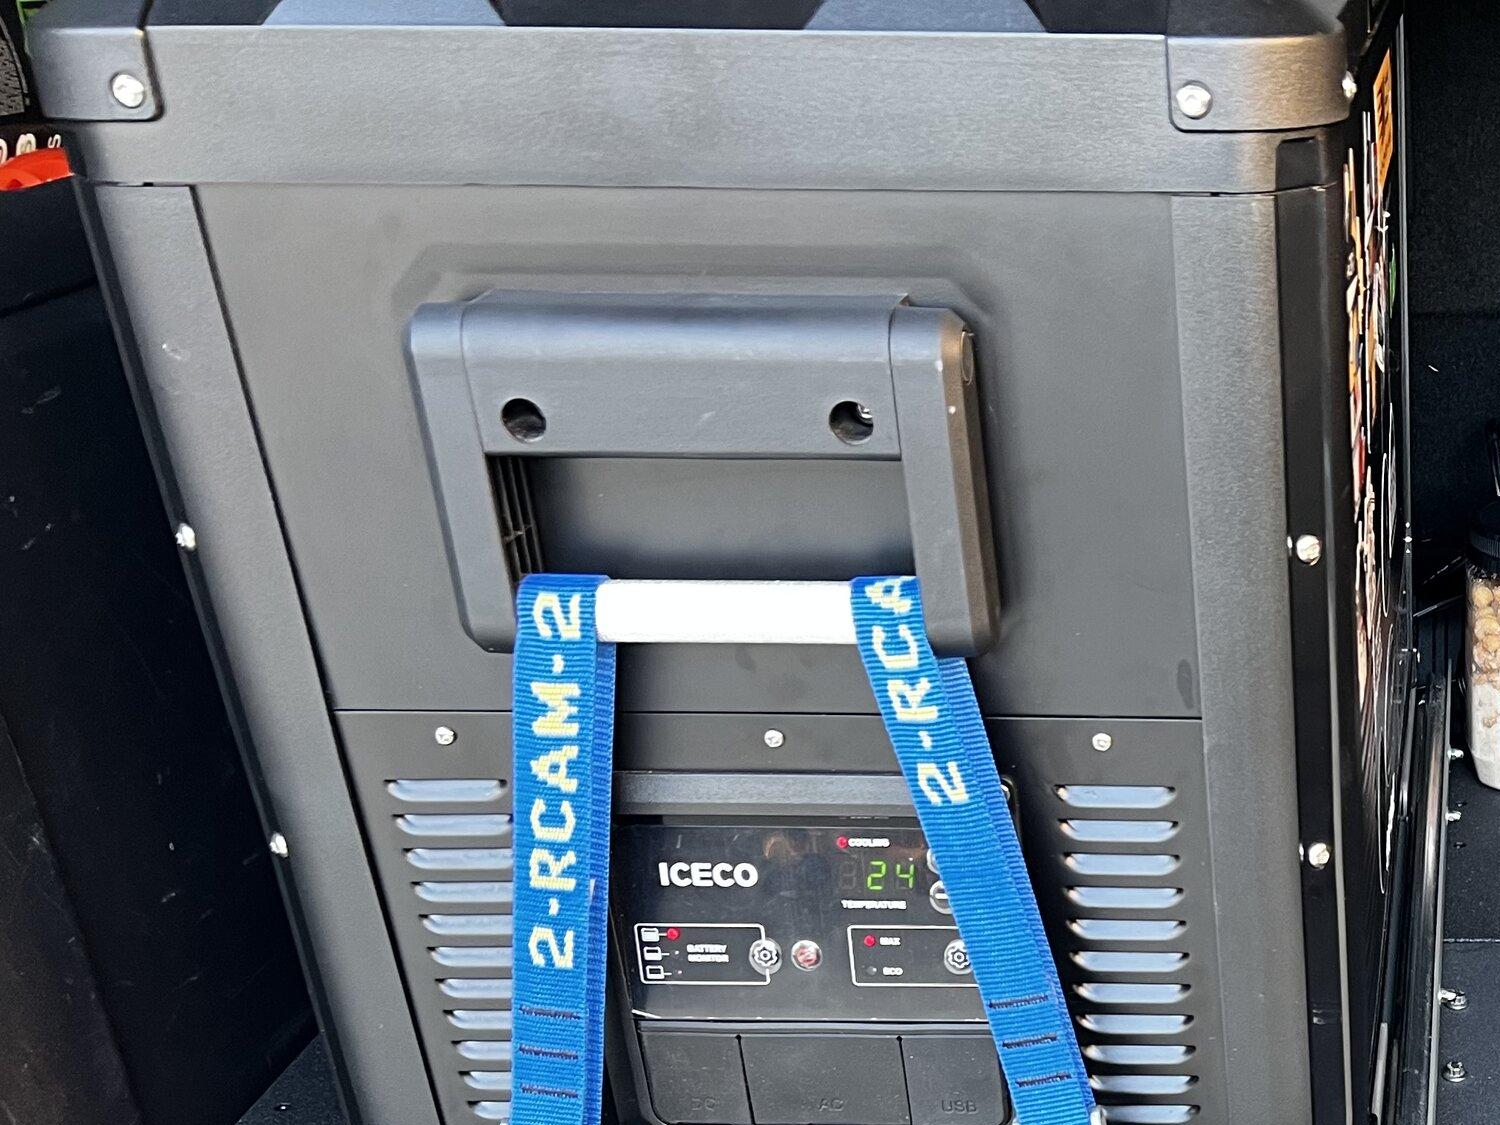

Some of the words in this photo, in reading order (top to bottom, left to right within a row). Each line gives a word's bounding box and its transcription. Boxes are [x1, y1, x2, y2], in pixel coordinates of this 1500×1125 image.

[527, 591, 582, 970] 2-RCAM-2
[658, 862, 759, 888] ICECO
[866, 860, 915, 891] 24
[941, 1099, 978, 1114] USB
